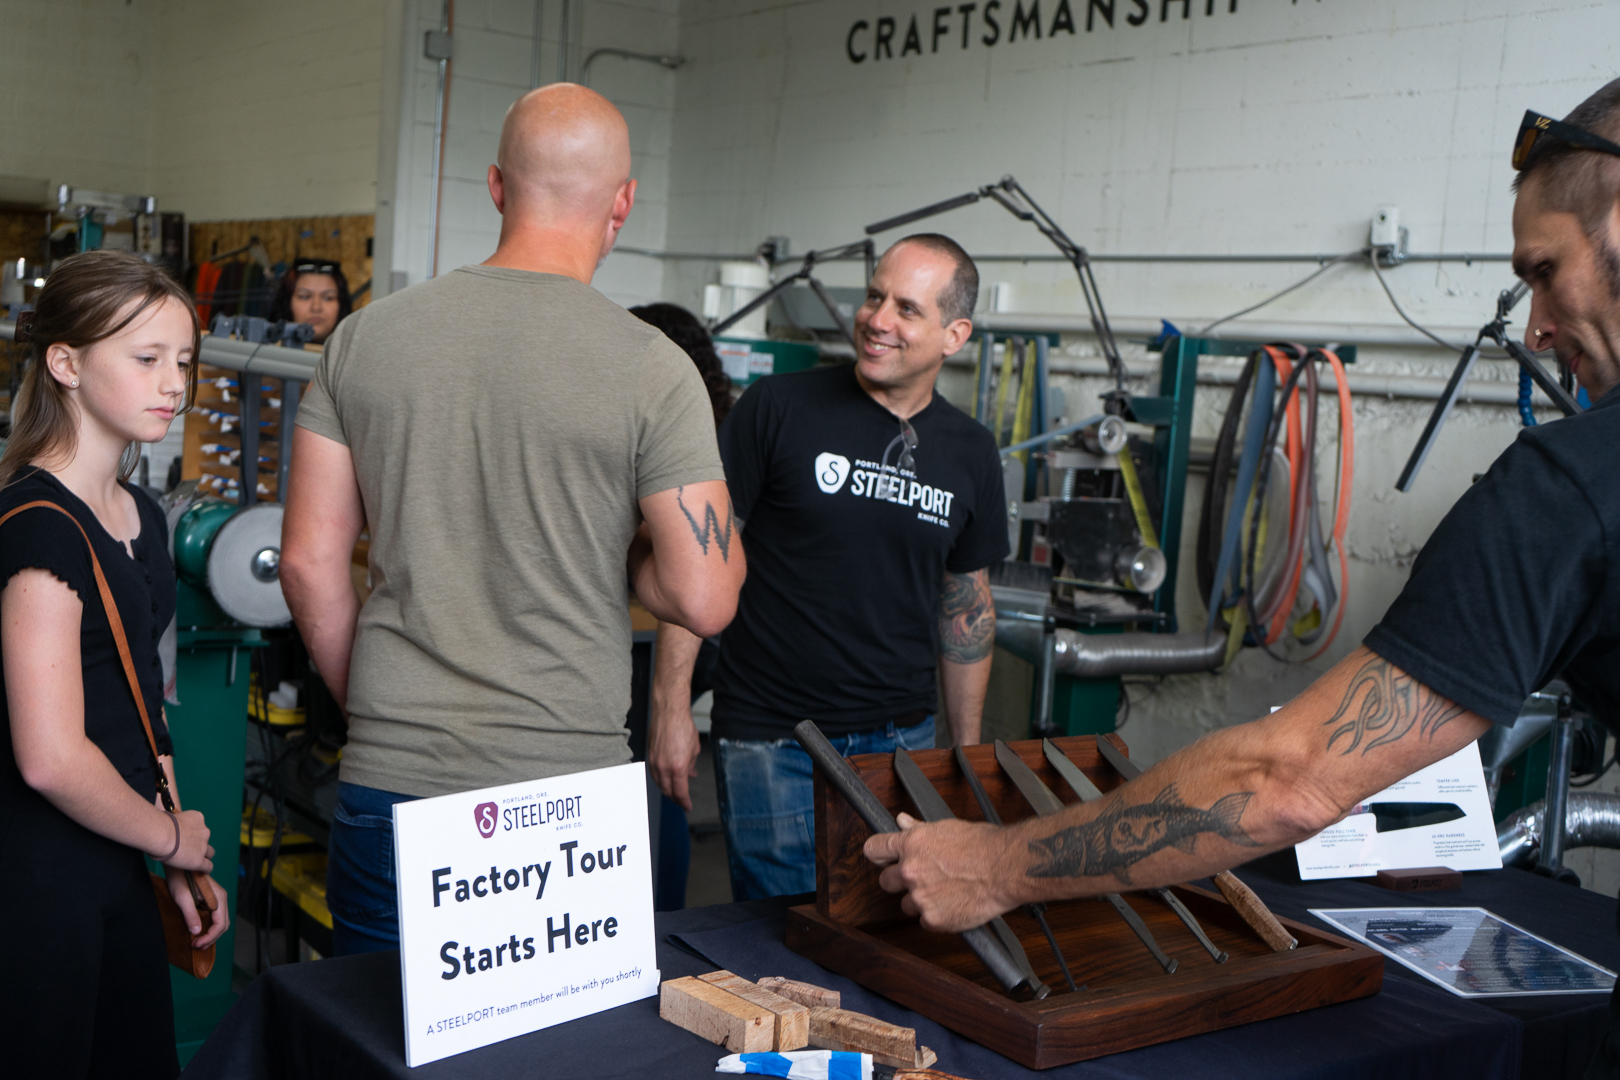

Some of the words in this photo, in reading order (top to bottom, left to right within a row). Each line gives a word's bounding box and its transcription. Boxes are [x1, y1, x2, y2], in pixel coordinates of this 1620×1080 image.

[850, 469, 955, 518] STEELPORT
[917, 512, 939, 525] KNIFE
[502, 794, 535, 804] PORTLAND,
[536, 791, 549, 799] ORE.
[503, 795, 582, 831] STEELPORT
[432, 861, 552, 908] Factory
[560, 840, 627, 877] Tour
[439, 934, 536, 981] Starts
[546, 912, 618, 954] Here
[426, 1025, 435, 1036] A
[436, 1006, 495, 1033] STEELPORT
[497, 1004, 518, 1016] team
[520, 992, 554, 1009] member
[555, 986, 569, 999] will
[570, 984, 580, 995] be
[582, 979, 599, 991] with
[600, 976, 614, 990] you
[616, 966, 642, 983] shortly
